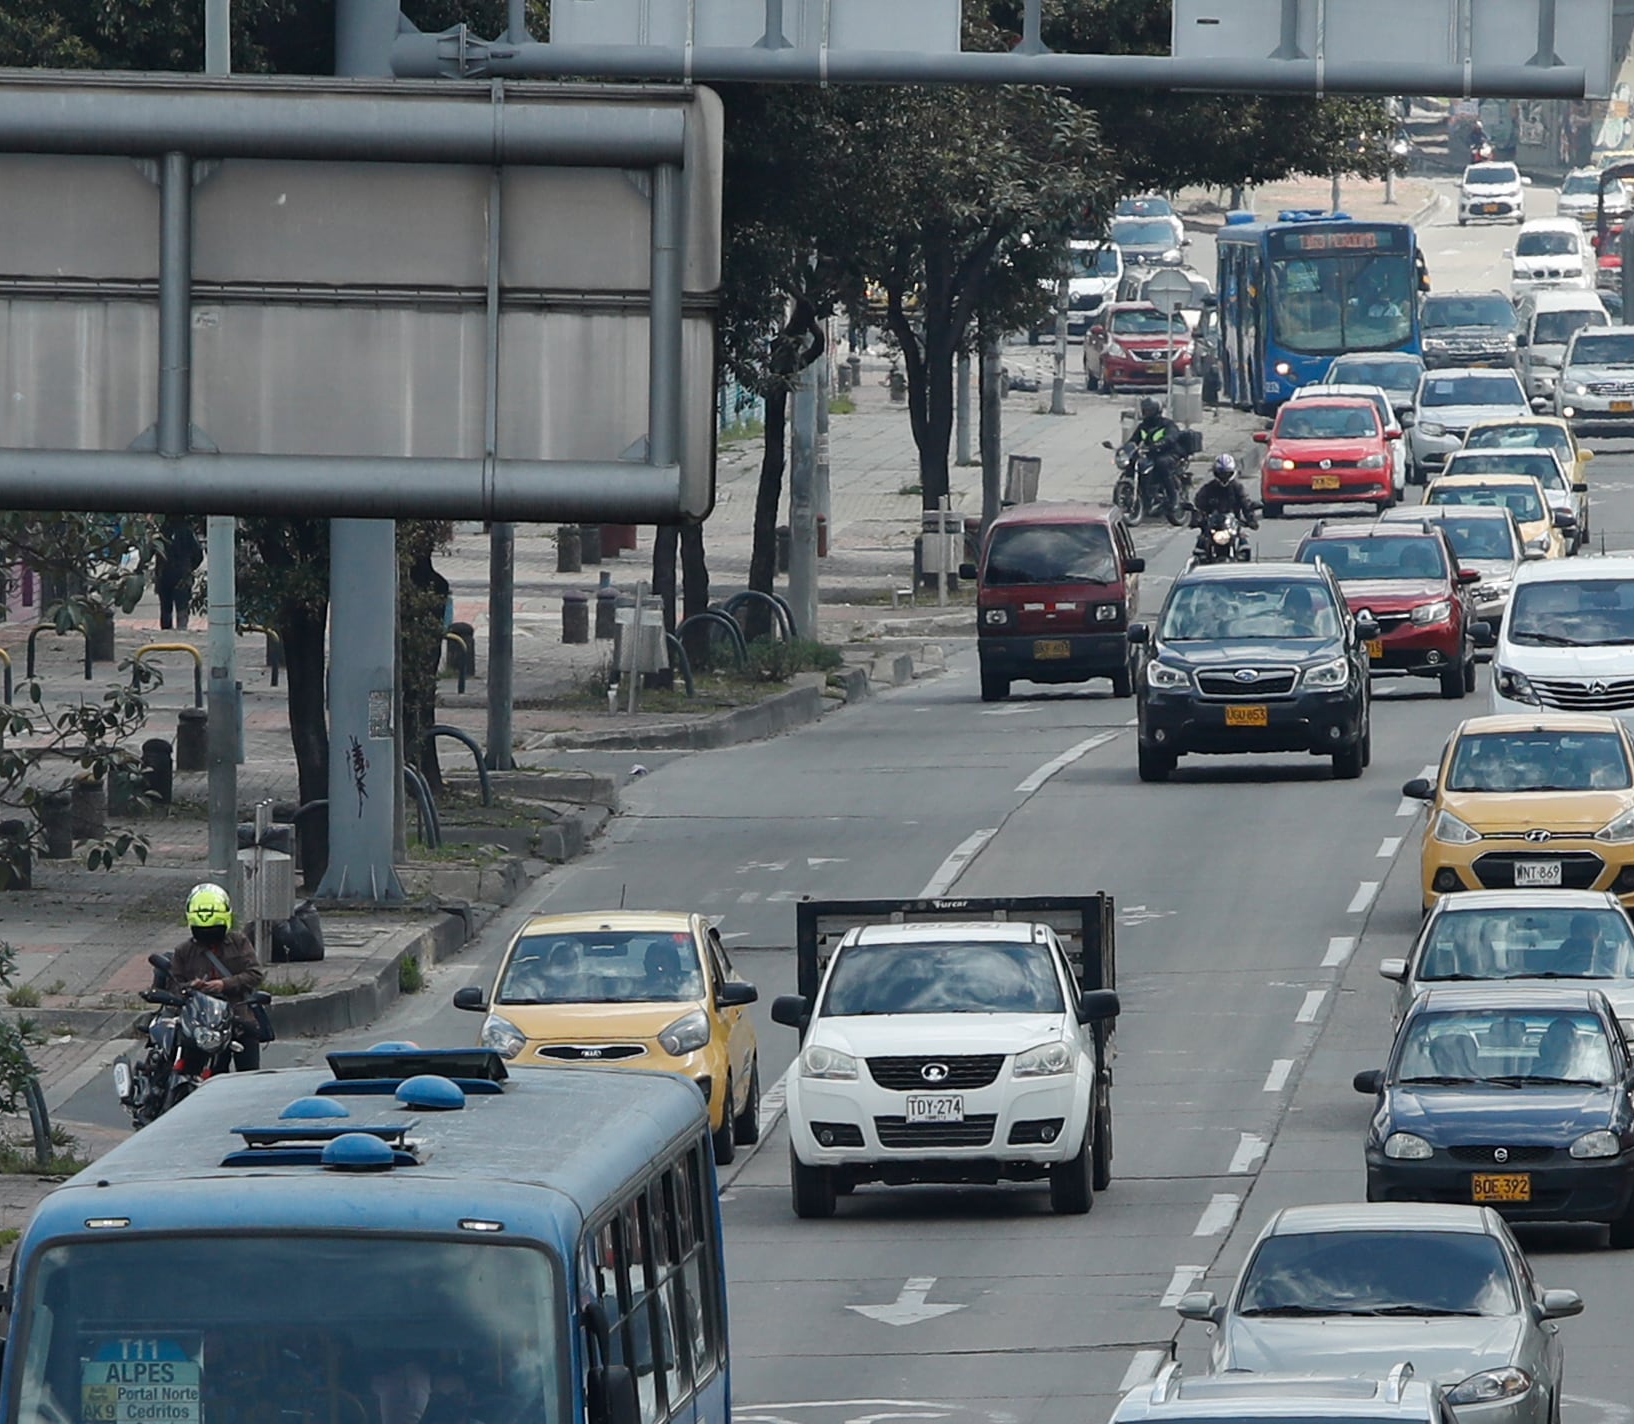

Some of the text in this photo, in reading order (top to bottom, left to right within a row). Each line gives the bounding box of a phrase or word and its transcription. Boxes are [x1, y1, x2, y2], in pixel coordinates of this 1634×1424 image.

[120, 1339, 158, 1360] T11
[106, 1363, 174, 1383] ALPES
[118, 1387, 198, 1400] Portal Norte
[127, 1404, 190, 1418] Cedritos
